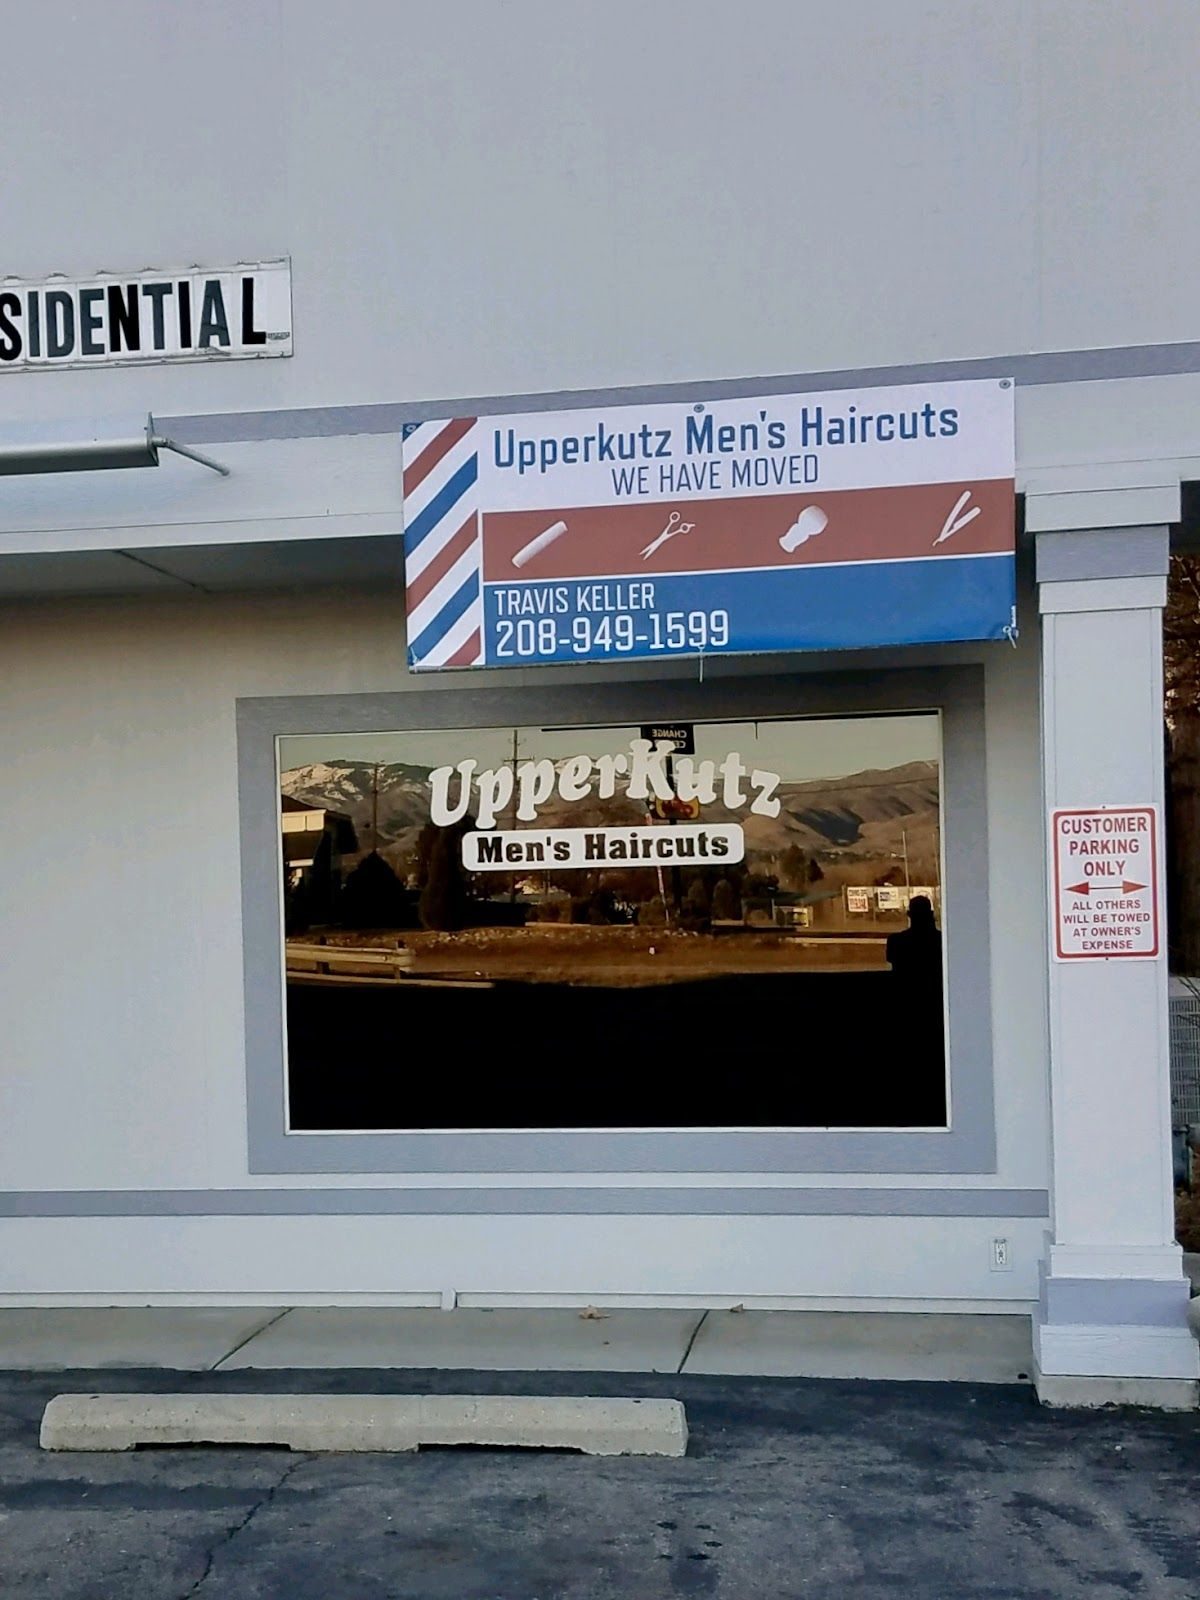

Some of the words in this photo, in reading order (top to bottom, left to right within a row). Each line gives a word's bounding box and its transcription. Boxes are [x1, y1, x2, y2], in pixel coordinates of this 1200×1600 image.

[0, 277, 267, 361] SIDENTIAL
[494, 422, 672, 475] Upperkutz
[686, 410, 786, 455] Men's
[801, 403, 958, 447] Haircuts
[611, 466, 649, 496] WE
[660, 461, 721, 493] HAVE
[732, 454, 818, 488] MOVED
[494, 587, 569, 616] TRAVIS
[577, 583, 655, 612] KELLER
[496, 610, 729, 657] 208-949-1599
[428, 738, 781, 829] UpperKutz
[1061, 816, 1147, 835] CUSTOMER
[477, 835, 571, 863] Men's
[584, 831, 729, 860] Haircuts
[1070, 839, 1139, 855] PARKING
[1084, 861, 1125, 876] ONLY
[1072, 901, 1092, 910] ALL
[1096, 899, 1141, 909] OTHERS
[1063, 915, 1089, 924] WILL
[1093, 914, 1107, 923] BE
[1111, 913, 1150, 922] TOWED
[1073, 927, 1087, 937] AT
[1091, 926, 1141, 936] OWNER'S
[1082, 940, 1133, 950] EXPENSE
